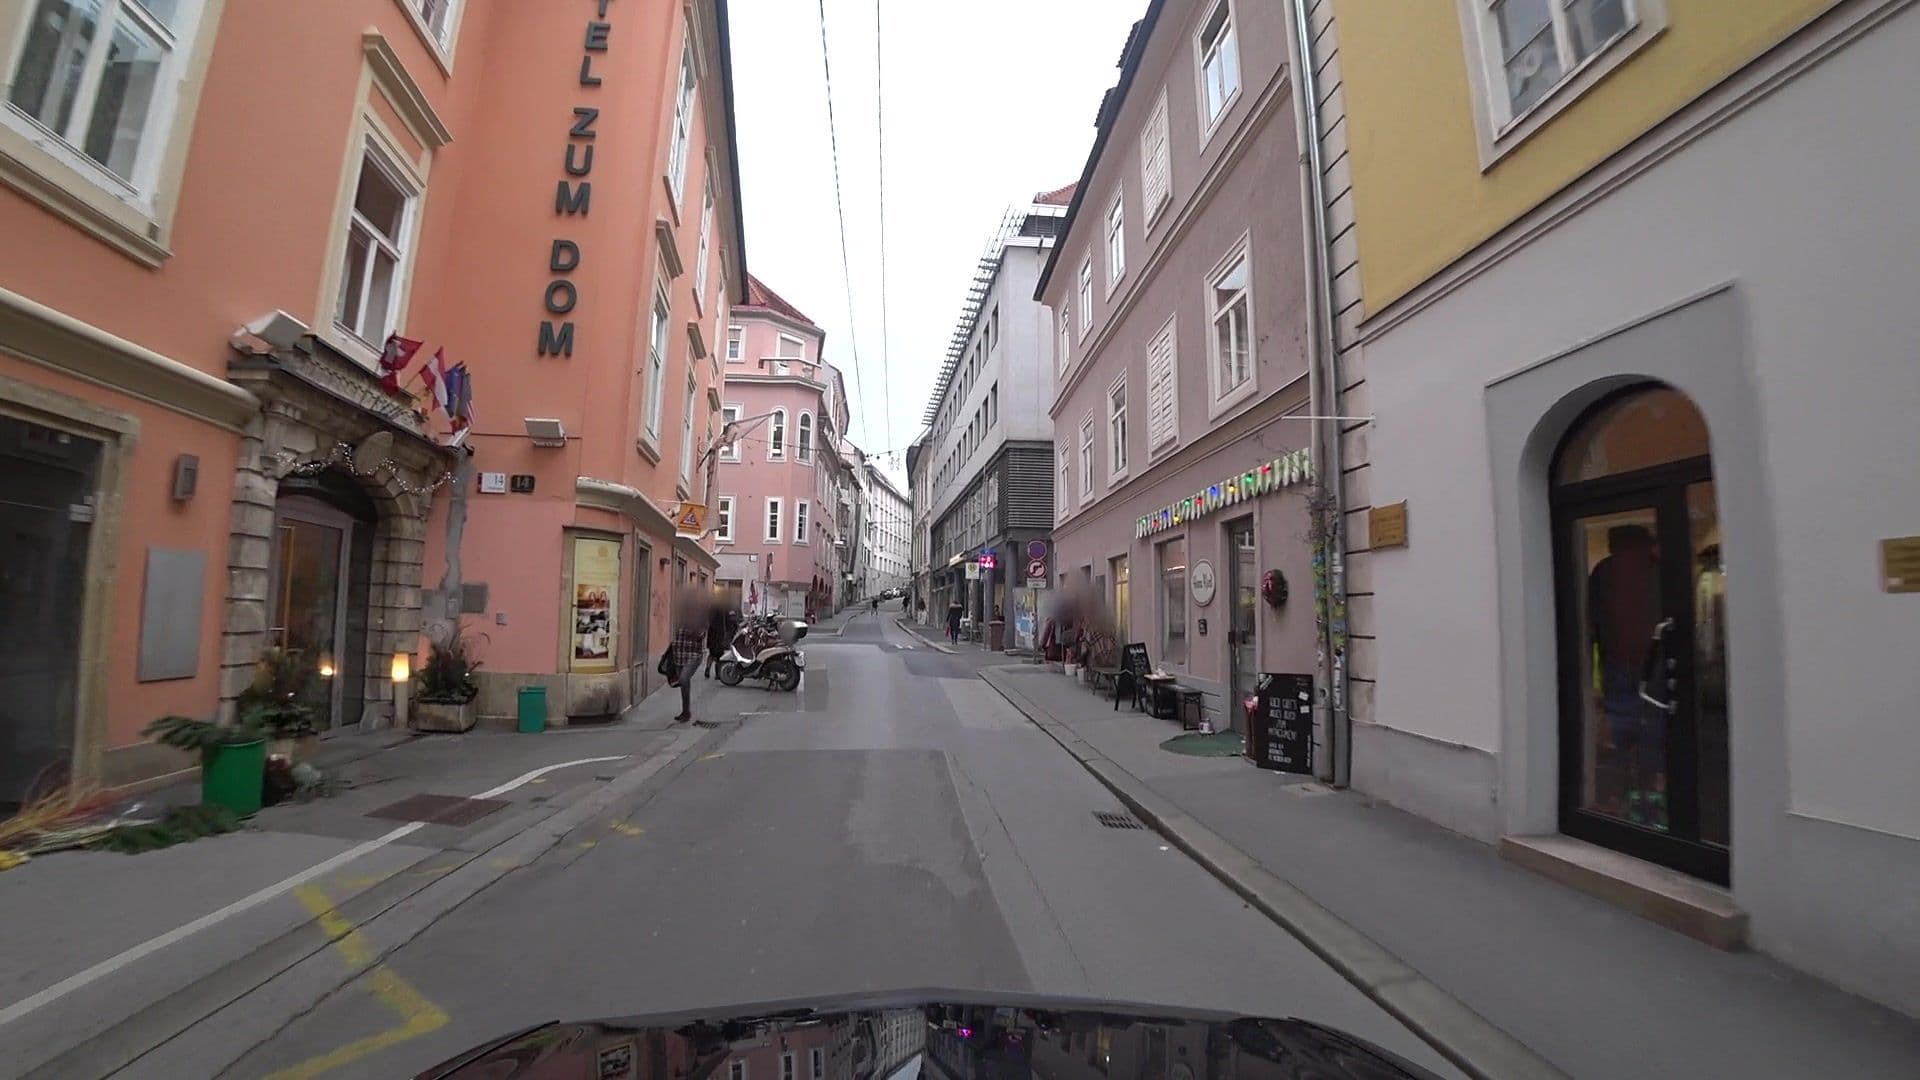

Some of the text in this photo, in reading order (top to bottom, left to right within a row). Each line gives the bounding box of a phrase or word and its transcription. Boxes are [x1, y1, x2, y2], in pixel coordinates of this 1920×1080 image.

[555, 107, 599, 216] ZUM
[537, 239, 580, 357] DOM
[516, 477, 530, 489] 14
